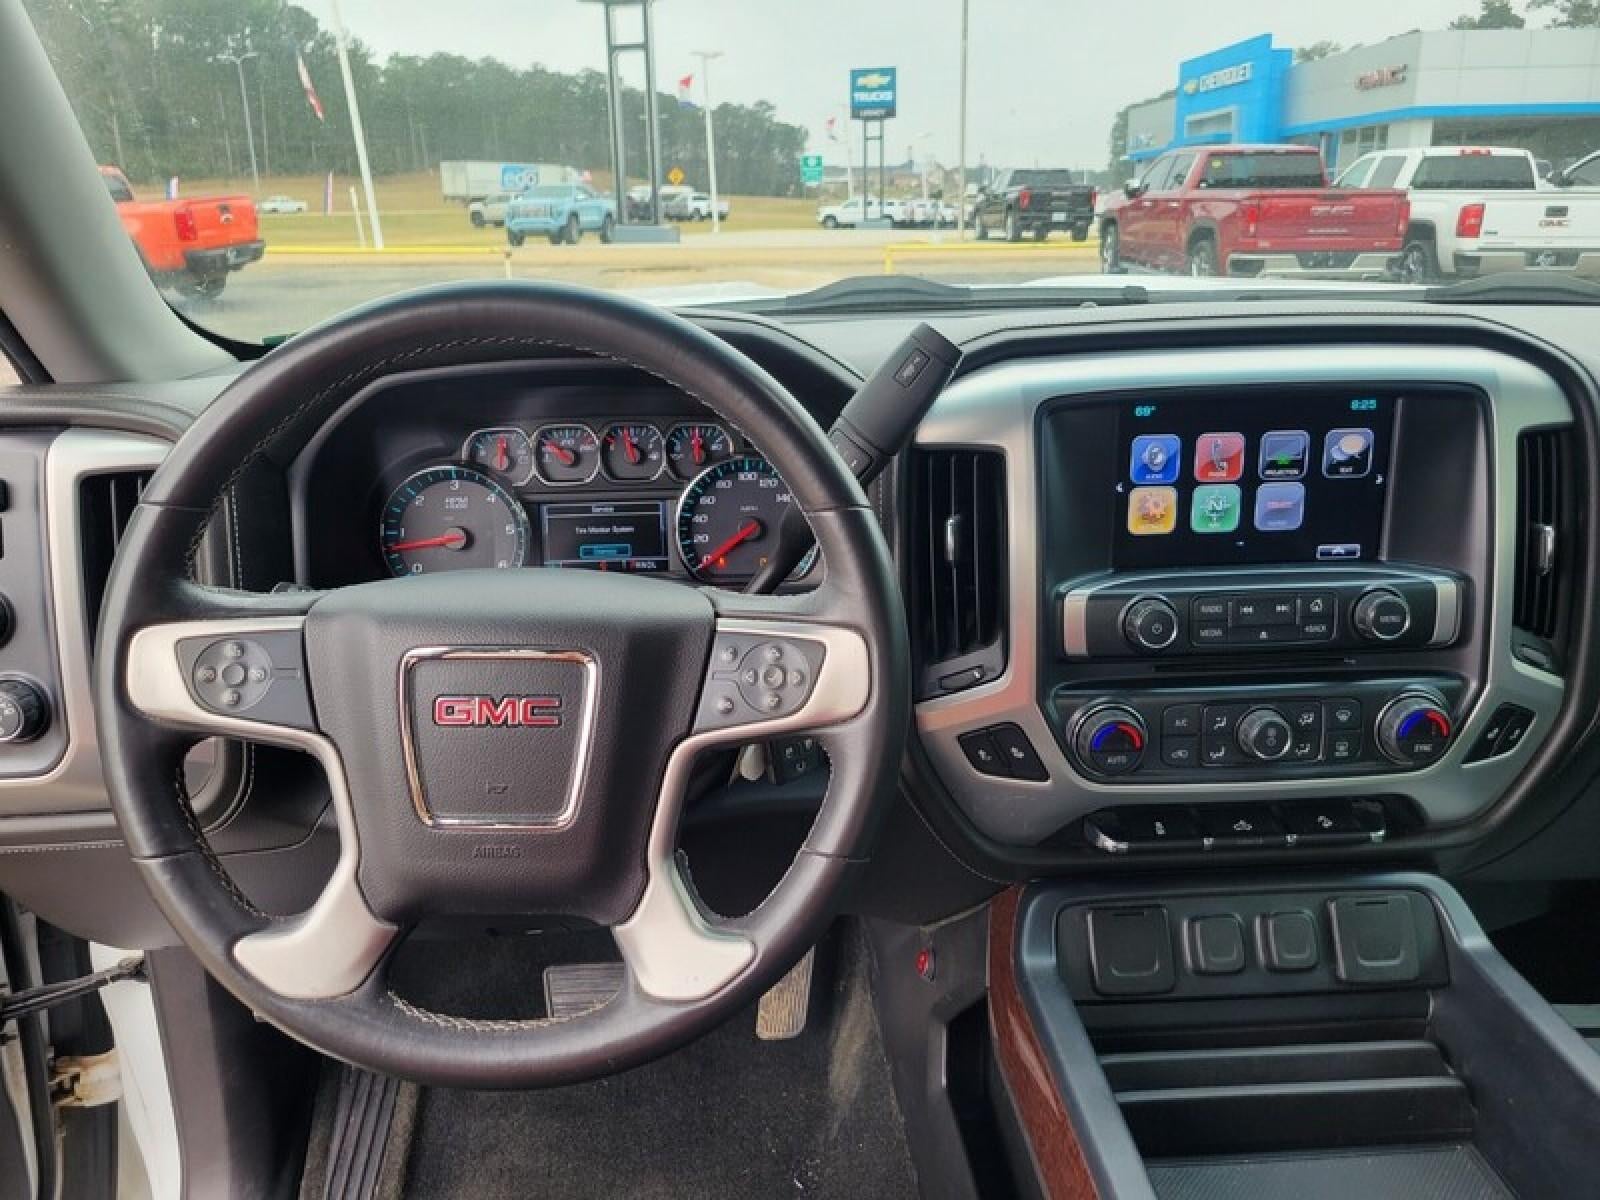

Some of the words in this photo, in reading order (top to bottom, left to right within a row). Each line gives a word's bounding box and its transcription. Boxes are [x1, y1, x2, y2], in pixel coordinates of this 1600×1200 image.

[1199, 62, 1254, 92] CHEVROLET
[1354, 64, 1408, 91] GMC
[738, 471, 758, 480] 100
[450, 480, 459, 491] 3
[716, 480, 732, 489] 80
[759, 479, 778, 488] 120
[415, 495, 425, 507] 2
[486, 493, 496, 504] 4
[700, 495, 716, 504] 60
[692, 514, 708, 523] 40
[505, 523, 515, 534] 5
[694, 533, 709, 542] 20
[411, 562, 423, 573] 0
[1201, 604, 1223, 613] RADIO
[1200, 627, 1223, 637] MEDIA
[433, 694, 562, 728] GMC
[1107, 755, 1127, 764] AUTO
[473, 846, 521, 859] AIRBAG
